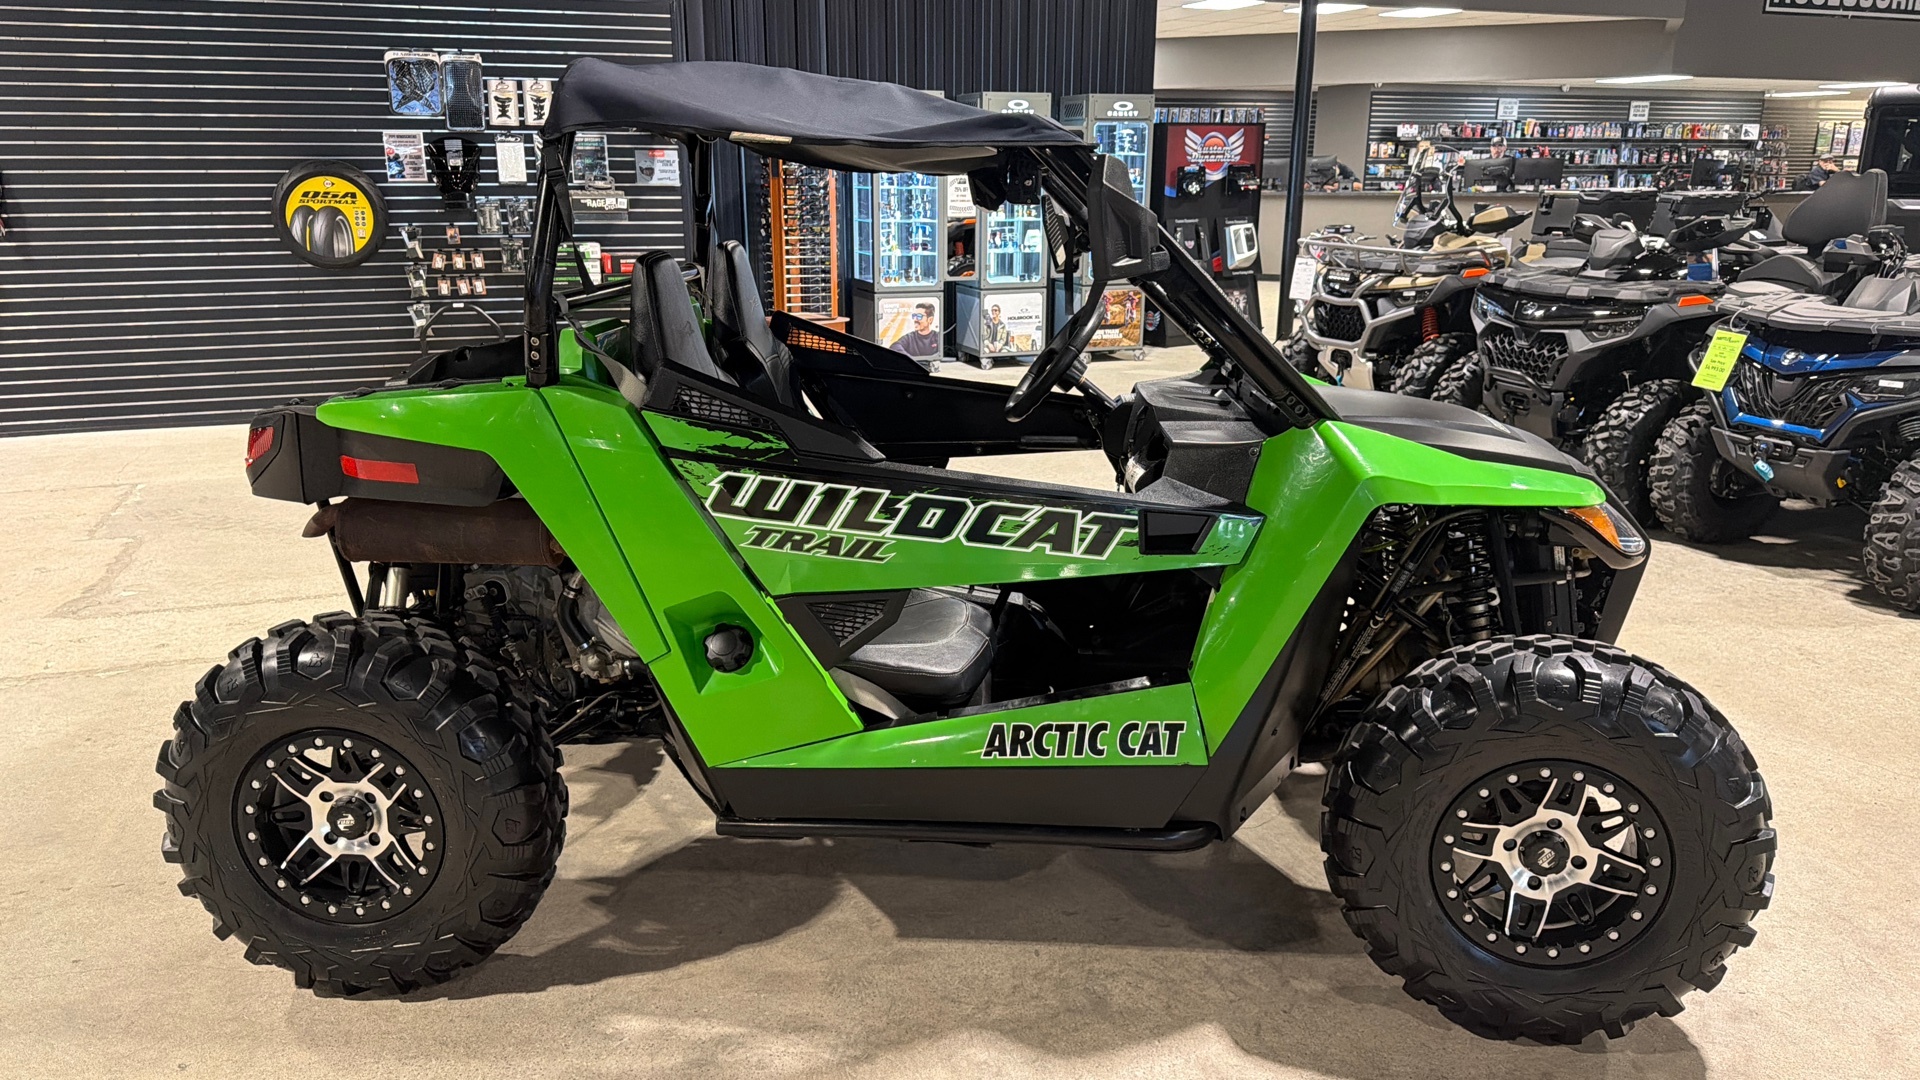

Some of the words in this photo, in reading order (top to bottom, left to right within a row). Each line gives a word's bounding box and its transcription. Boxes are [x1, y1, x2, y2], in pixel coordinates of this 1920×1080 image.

[587, 199, 606, 208] RAGE
[706, 471, 1140, 561] WILDCAT
[739, 524, 897, 564] TRAIL
[980, 721, 1111, 759] ARCTIC
[1117, 720, 1187, 758] CAT
